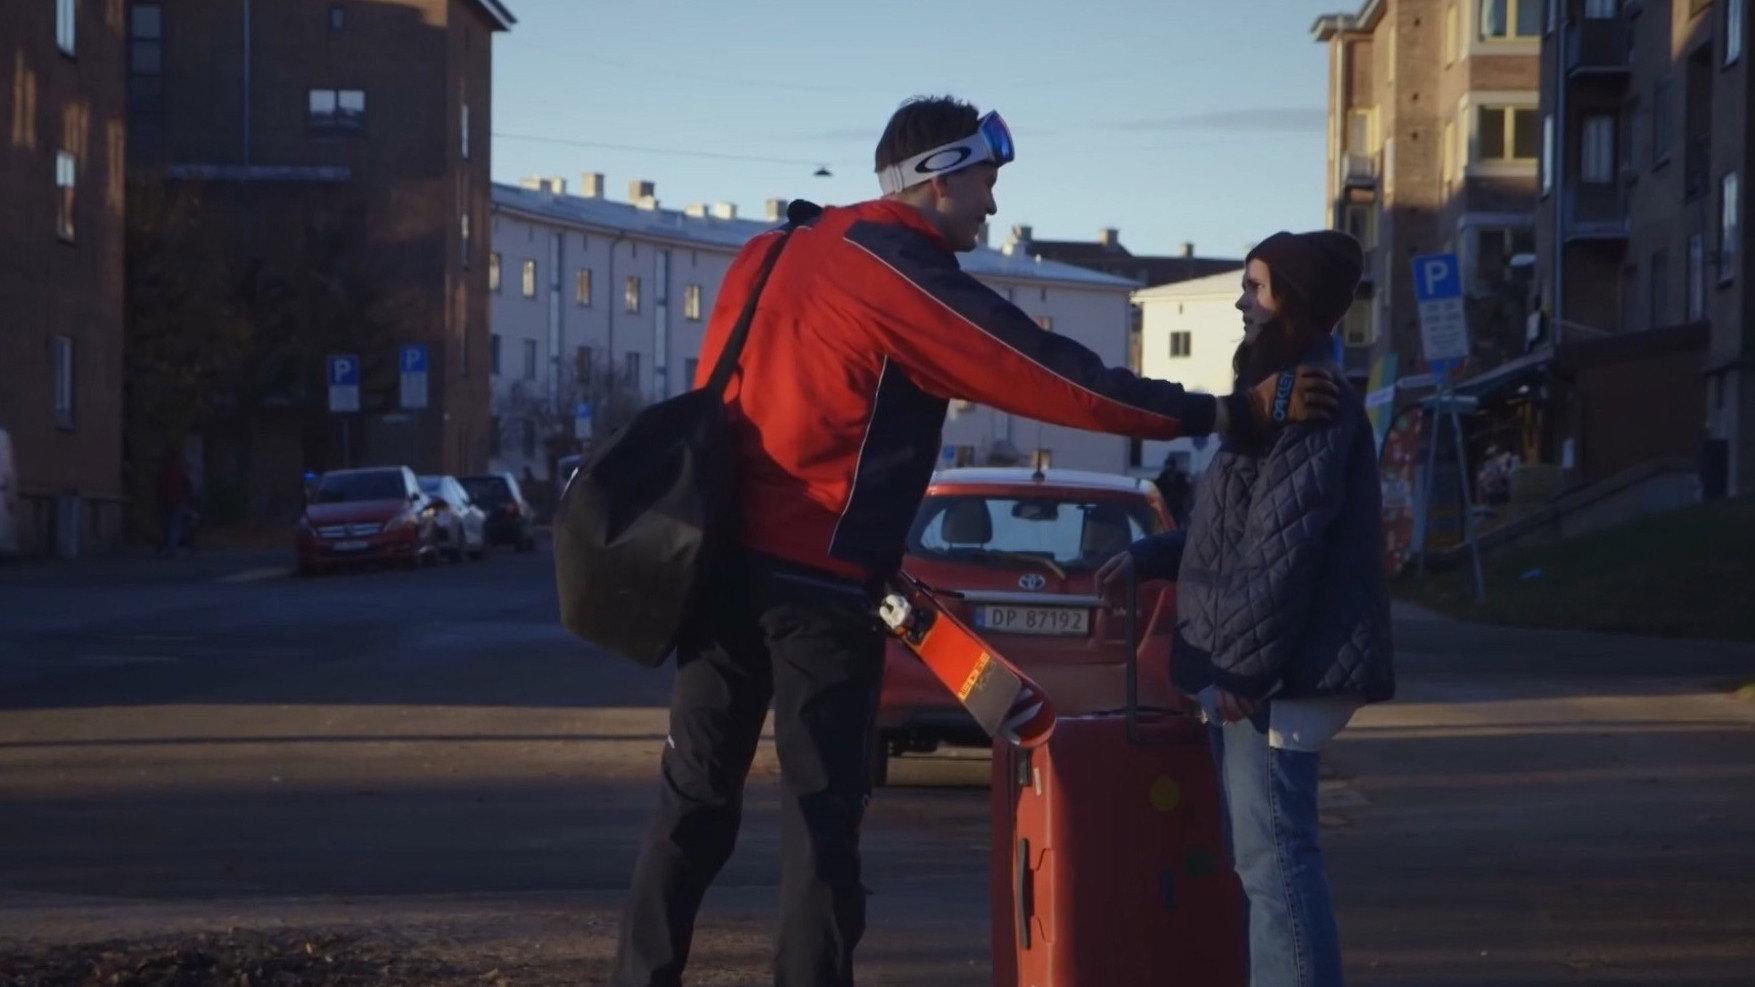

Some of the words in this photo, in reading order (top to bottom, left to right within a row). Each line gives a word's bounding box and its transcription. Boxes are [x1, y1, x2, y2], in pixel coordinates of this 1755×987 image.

[1425, 262, 1448, 295] P
[334, 358, 351, 383] P
[406, 349, 421, 371] P
[992, 609, 1016, 626] DP
[1026, 610, 1082, 630] 87192
